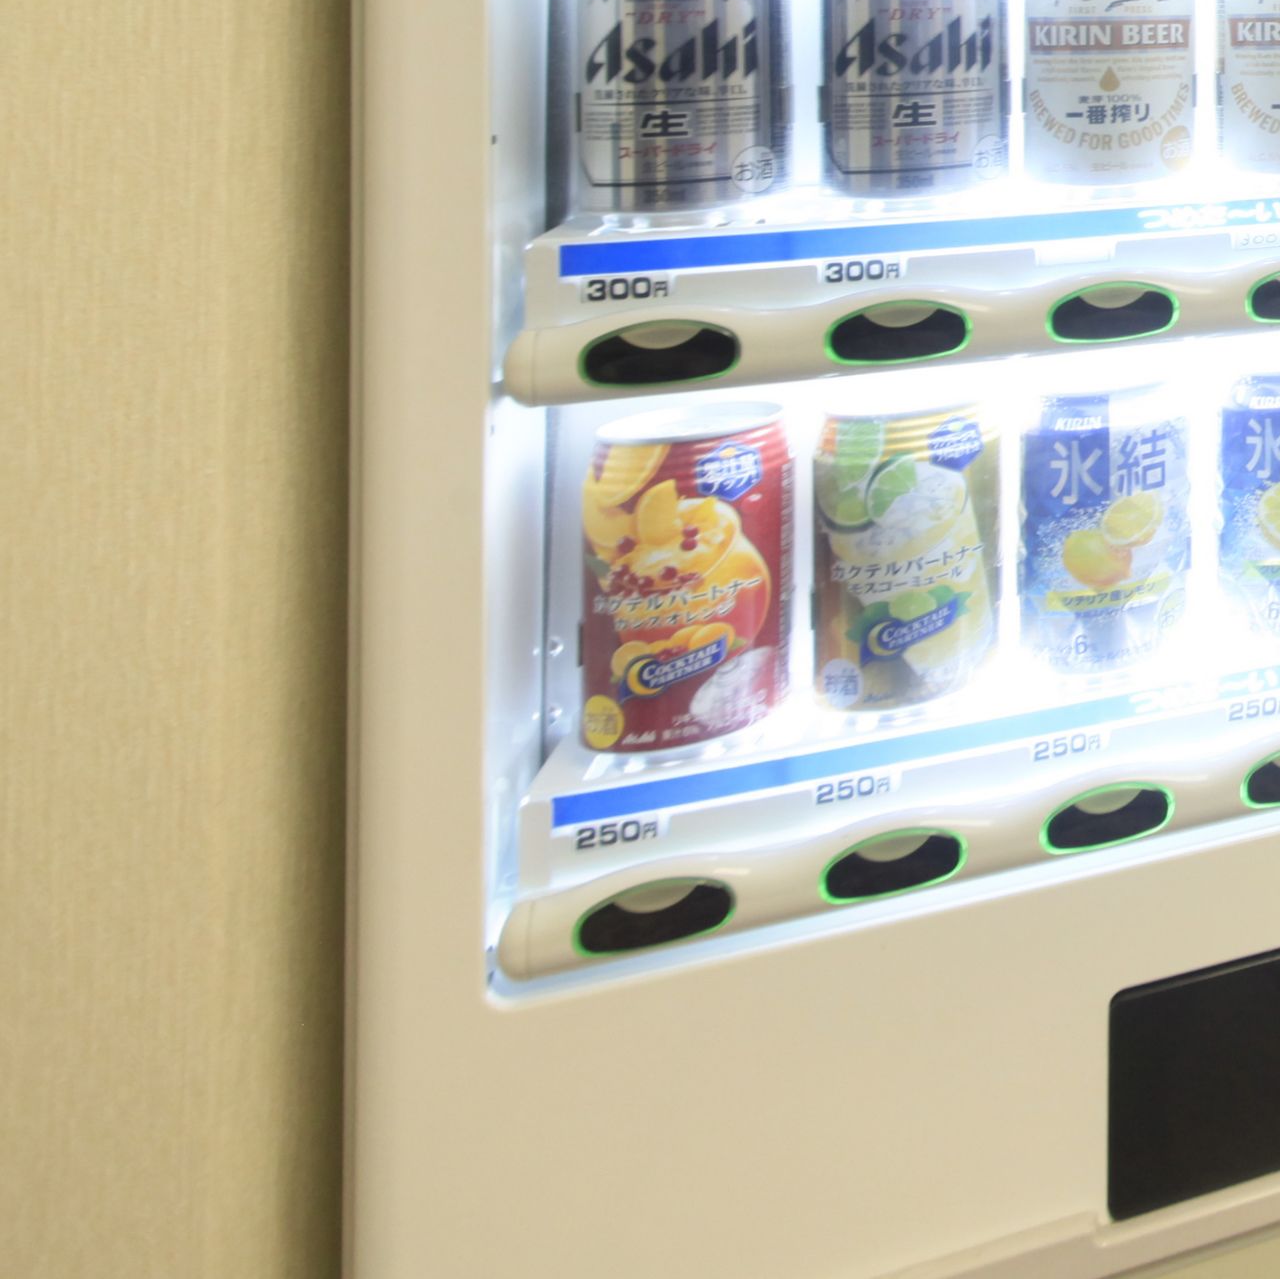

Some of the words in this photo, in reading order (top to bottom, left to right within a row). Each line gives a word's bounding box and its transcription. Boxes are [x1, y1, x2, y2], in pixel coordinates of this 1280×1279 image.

[836, 12, 993, 79] Asahi
[1034, 24, 1113, 47] KIRIN
[1122, 23, 1184, 46] BEER
[585, 17, 760, 84] Asahi
[640, 109, 689, 139] 生
[892, 101, 937, 128] 生
[1066, 102, 1151, 125] 一番搾り
[618, 140, 718, 158] スーパードライ
[824, 260, 900, 283] 300円
[586, 277, 669, 302] 300円
[1050, 428, 1168, 505] 氷結
[832, 543, 984, 582] カクテルパートナー
[594, 577, 762, 613] カクテルパートナー
[1033, 732, 1102, 762] 250円
[816, 772, 892, 804] 250円
[575, 818, 660, 850] 250円
